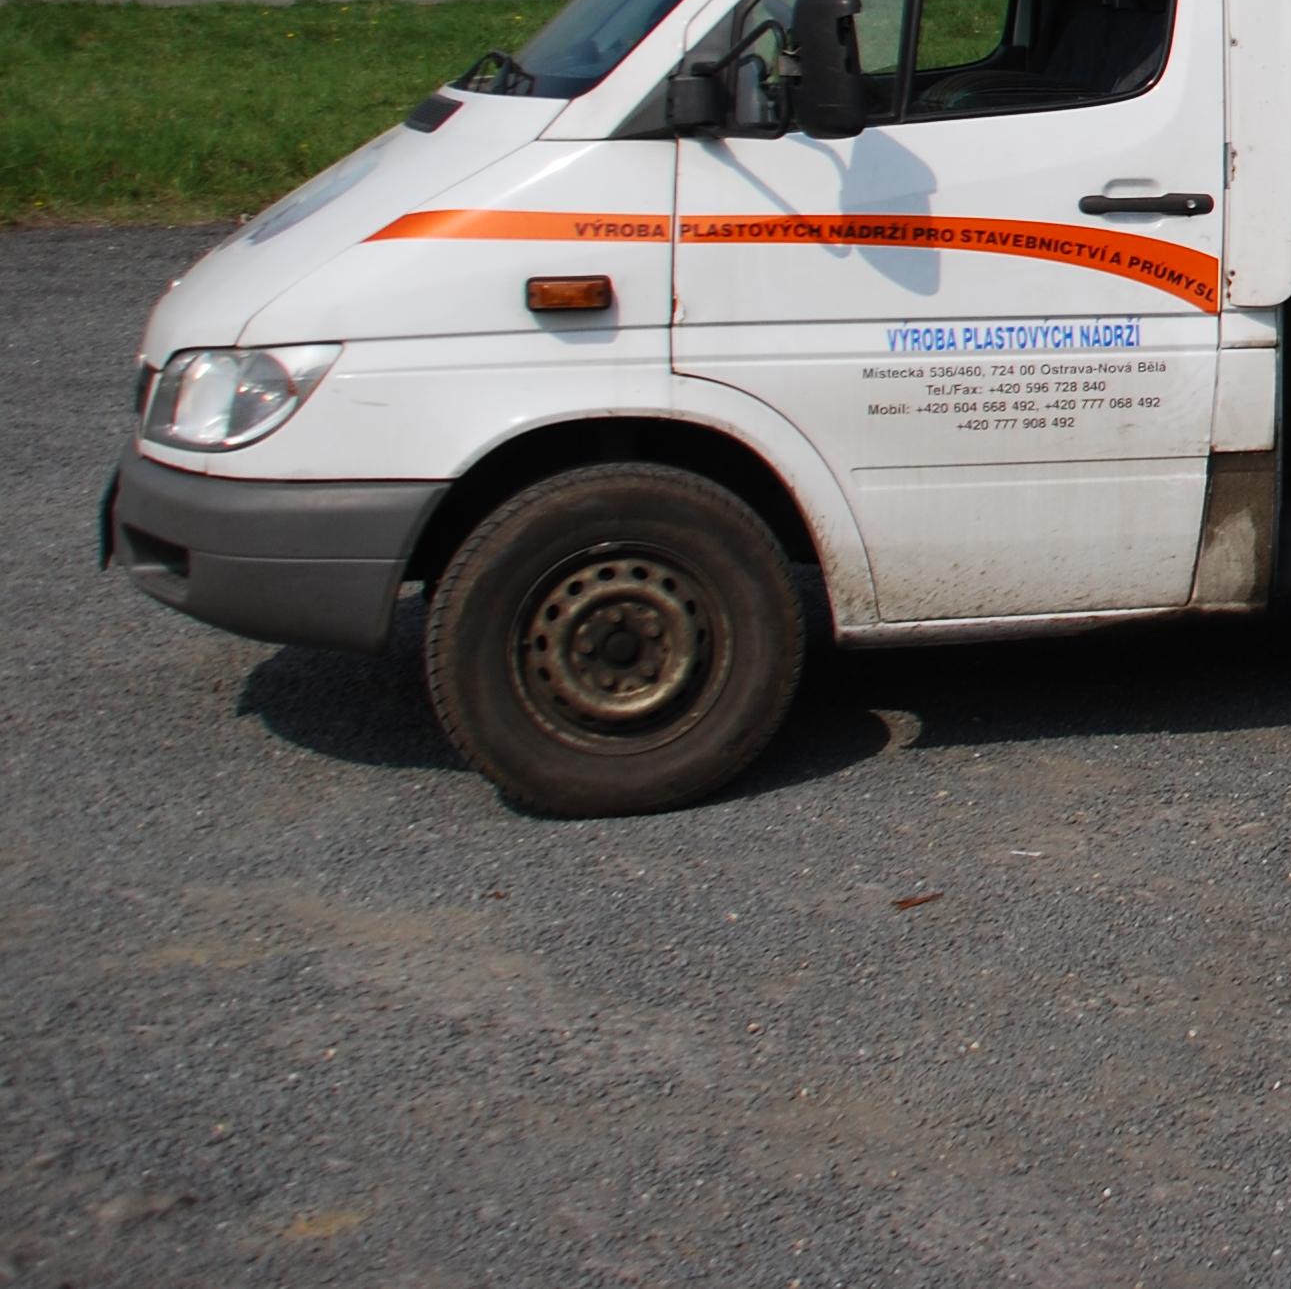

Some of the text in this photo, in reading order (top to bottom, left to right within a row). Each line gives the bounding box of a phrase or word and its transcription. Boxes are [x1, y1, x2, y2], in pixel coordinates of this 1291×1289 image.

[574, 218, 665, 238] VÝROBA
[679, 217, 821, 240] PLASTOVÝCH
[828, 217, 907, 241] NÁDRŽÍ
[912, 227, 954, 243] PRO
[960, 229, 1108, 262] STAVEBNICTVÍ
[1109, 251, 1121, 266] A
[887, 315, 1140, 352] VÝROBA PLASTOVÝCH NÁDRŽÍ
[862, 360, 1167, 379] Místecká 536/460, 724 00 Ostrava-Nová Bělá
[926, 380, 1106, 396] Tel./Fax: +420 596 728 840
[868, 396, 1161, 416] Mobil: +420 604 668 492, +420 777 068 492
[957, 416, 1075, 431] +420 777 908 492
